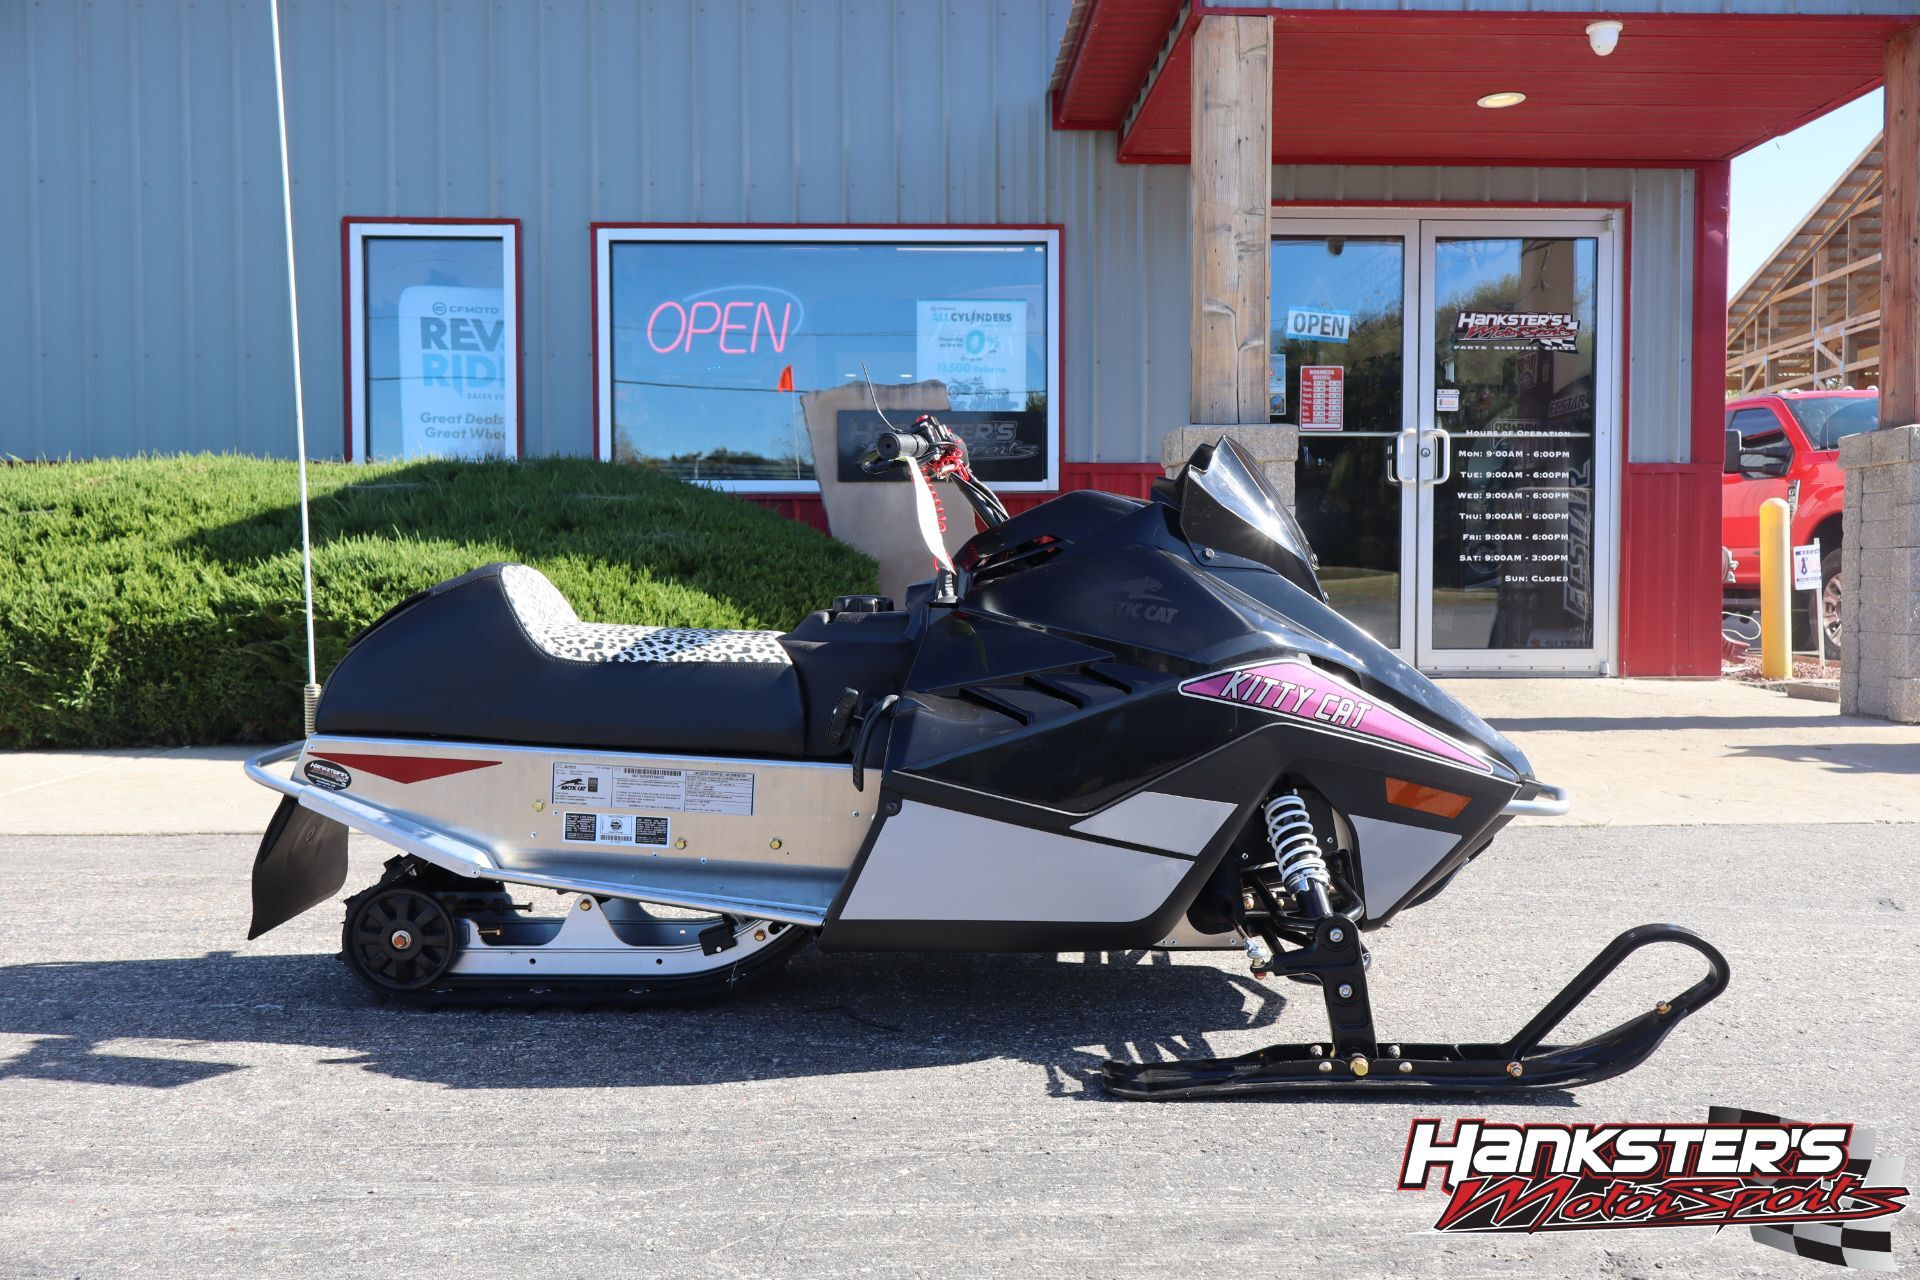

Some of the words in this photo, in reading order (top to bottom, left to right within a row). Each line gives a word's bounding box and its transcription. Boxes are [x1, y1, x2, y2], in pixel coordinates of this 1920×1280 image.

[449, 305, 499, 314] CFMOTO
[647, 301, 791, 353] OPEN
[1293, 312, 1345, 337] OPEN
[420, 412, 462, 423] Great
[424, 426, 466, 438] Great
[1459, 554, 1481, 562] SAT:
[1484, 554, 1522, 562] 9:00AM
[1531, 554, 1568, 562] 3:00PM
[1220, 671, 1316, 714] KITTY
[1314, 692, 1374, 729] CAT
